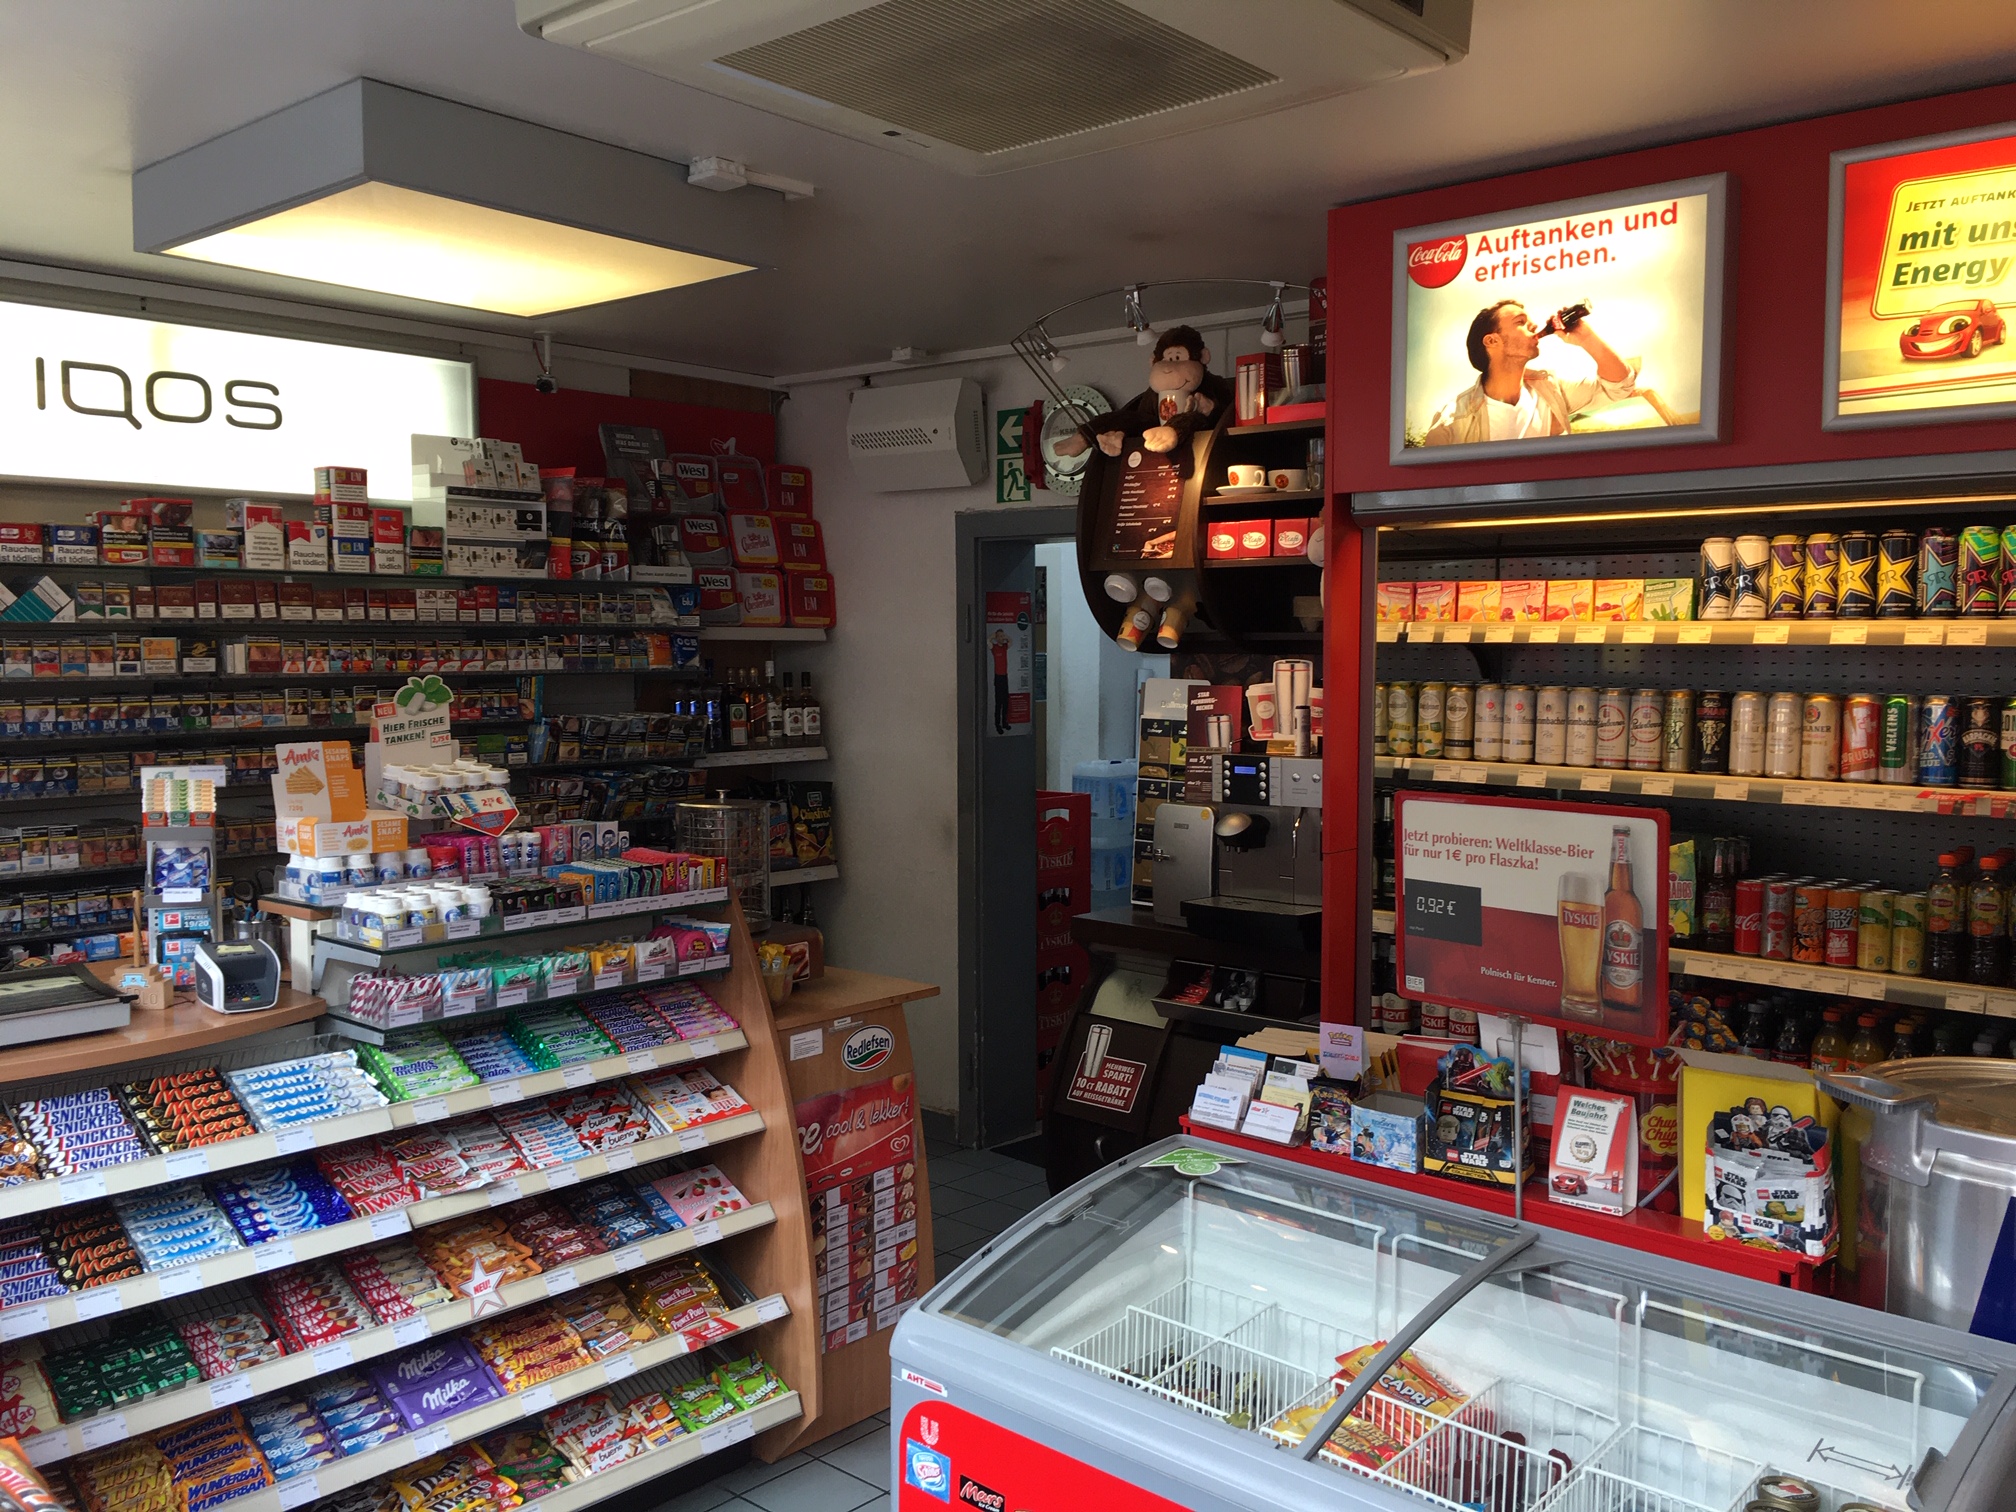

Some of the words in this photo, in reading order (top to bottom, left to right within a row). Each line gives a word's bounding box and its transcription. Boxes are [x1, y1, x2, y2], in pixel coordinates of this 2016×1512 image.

[1906, 199, 1946, 213] JETZT
[1475, 218, 1613, 257] Auftanken
[1624, 202, 1679, 232] und
[1898, 221, 1957, 252] mit
[1409, 239, 1465, 268] Coca-Cola
[1475, 246, 1618, 283] erfrischen.
[1892, 257, 2010, 287] Energy
[36, 357, 282, 430] IQOS
[679, 463, 707, 477] West
[687, 518, 715, 532] West
[1, 545, 41, 554] Rauchen
[58, 546, 96, 555] Rauchen
[293, 551, 326, 560] Rauchen
[302, 558, 327, 567] tödlich
[378, 562, 402, 570] tödlich
[702, 575, 729, 588] West
[677, 638, 698, 647] OCB
[376, 706, 394, 716] NEU
[383, 722, 405, 735] HIER
[408, 716, 446, 732] FRISCHE
[1885, 707, 1899, 752] VELTINS
[384, 730, 426, 748] TANKEN!
[281, 748, 320, 766] Amki
[324, 747, 350, 756] SESAME
[325, 754, 350, 763] SNAPS
[342, 824, 370, 838] Amki
[377, 820, 402, 828] SESAME
[377, 827, 402, 836] SNAPS
[1403, 828, 1429, 844] Jetzt
[1431, 831, 1493, 850] probieren:
[1495, 834, 1595, 860] Weltklasse-Bier
[1403, 844, 1420, 857] für
[1422, 849, 1442, 860] nur
[1445, 848, 1462, 862] 1€
[1465, 854, 1487, 867] pro
[1489, 853, 1540, 871] Flaszka!
[1416, 897, 1445, 914] 0,92
[1446, 900, 1457, 916] €
[184, 920, 210, 929] 19/20
[1563, 909, 1600, 928] TYSKIE
[1606, 948, 1641, 967] YSKIE
[1407, 976, 1424, 986] BIER
[1480, 966, 1513, 980] Polnisch
[1514, 971, 1526, 982] für
[1527, 974, 1559, 988] Kenner.
[660, 998, 693, 1013] mentos
[1421, 1017, 1447, 1029] YSKIE
[846, 1036, 891, 1060] Redlefsen
[246, 1060, 311, 1080] BOUNTY
[1101, 1068, 1133, 1085] SPART!
[1104, 1061, 1135, 1074] MEHRWEG
[148, 1067, 217, 1095] Mars
[250, 1072, 316, 1092] BOUNTY
[260, 1080, 326, 1099] BOUNTY
[1075, 1077, 1087, 1088] 10
[1094, 1081, 1132, 1099] RABATT
[19, 1101, 36, 1117] 2
[40, 1087, 109, 1114] SNICKERS
[153, 1080, 223, 1107] Mars
[264, 1091, 328, 1112] BOUNTY
[1071, 1089, 1083, 1098] AUF
[1083, 1091, 1127, 1108] HEISSGETRÄNKE
[163, 1089, 233, 1119] Mars
[272, 1100, 338, 1120] BOUNTY
[1573, 1099, 1606, 1113] Welches
[29, 1115, 45, 1129] 2
[50, 1100, 119, 1126] SNICKERS
[171, 1102, 241, 1130] Mars
[588, 1114, 616, 1129] bueno
[825, 1112, 854, 1139] cool
[855, 1110, 866, 1130] &
[869, 1096, 910, 1127] lekker!
[1570, 1108, 1608, 1121] Baujahr?
[1647, 1115, 1677, 1131] Chup
[32, 1128, 49, 1143] 2
[54, 1112, 124, 1138] SNICKERS
[1646, 1128, 1677, 1143] Chup
[43, 1138, 60, 1155] 2
[65, 1124, 135, 1150] SNICKERS
[607, 1130, 635, 1146] bueno
[71, 1138, 141, 1164] SNICKERS
[391, 1139, 447, 1158] TWIX
[1462, 1151, 1488, 1161] STAR
[332, 1154, 389, 1178] TWIX
[404, 1157, 457, 1178] TWIX
[1460, 1158, 1488, 1168] WARS
[342, 1171, 398, 1195] TWIX
[355, 1186, 411, 1215] TWIX
[1771, 1189, 1798, 1197] STAR
[1771, 1194, 1800, 1202] WARS
[620, 1222, 650, 1238] YES!
[556, 1243, 586, 1257] YES!
[473, 1278, 492, 1294] NEU!
[657, 1293, 676, 1309] PRINCE
[676, 1285, 695, 1301] POLO
[671, 1312, 690, 1331] PRINCE
[688, 1305, 708, 1321] POLO
[398, 1347, 447, 1379] Milka
[906, 1372, 925, 1387] AHT
[422, 1378, 472, 1411] Milka
[1378, 1373, 1437, 1409] CAPRI
[156, 1410, 234, 1451] WUNDERBAR
[589, 1417, 615, 1438] bueno
[597, 1443, 624, 1463] bueno
[97, 1463, 147, 1488] LION
[187, 1462, 264, 1499] WUNDERBAR
[109, 1478, 158, 1504] LION
[959, 1480, 1004, 1510] Mars
